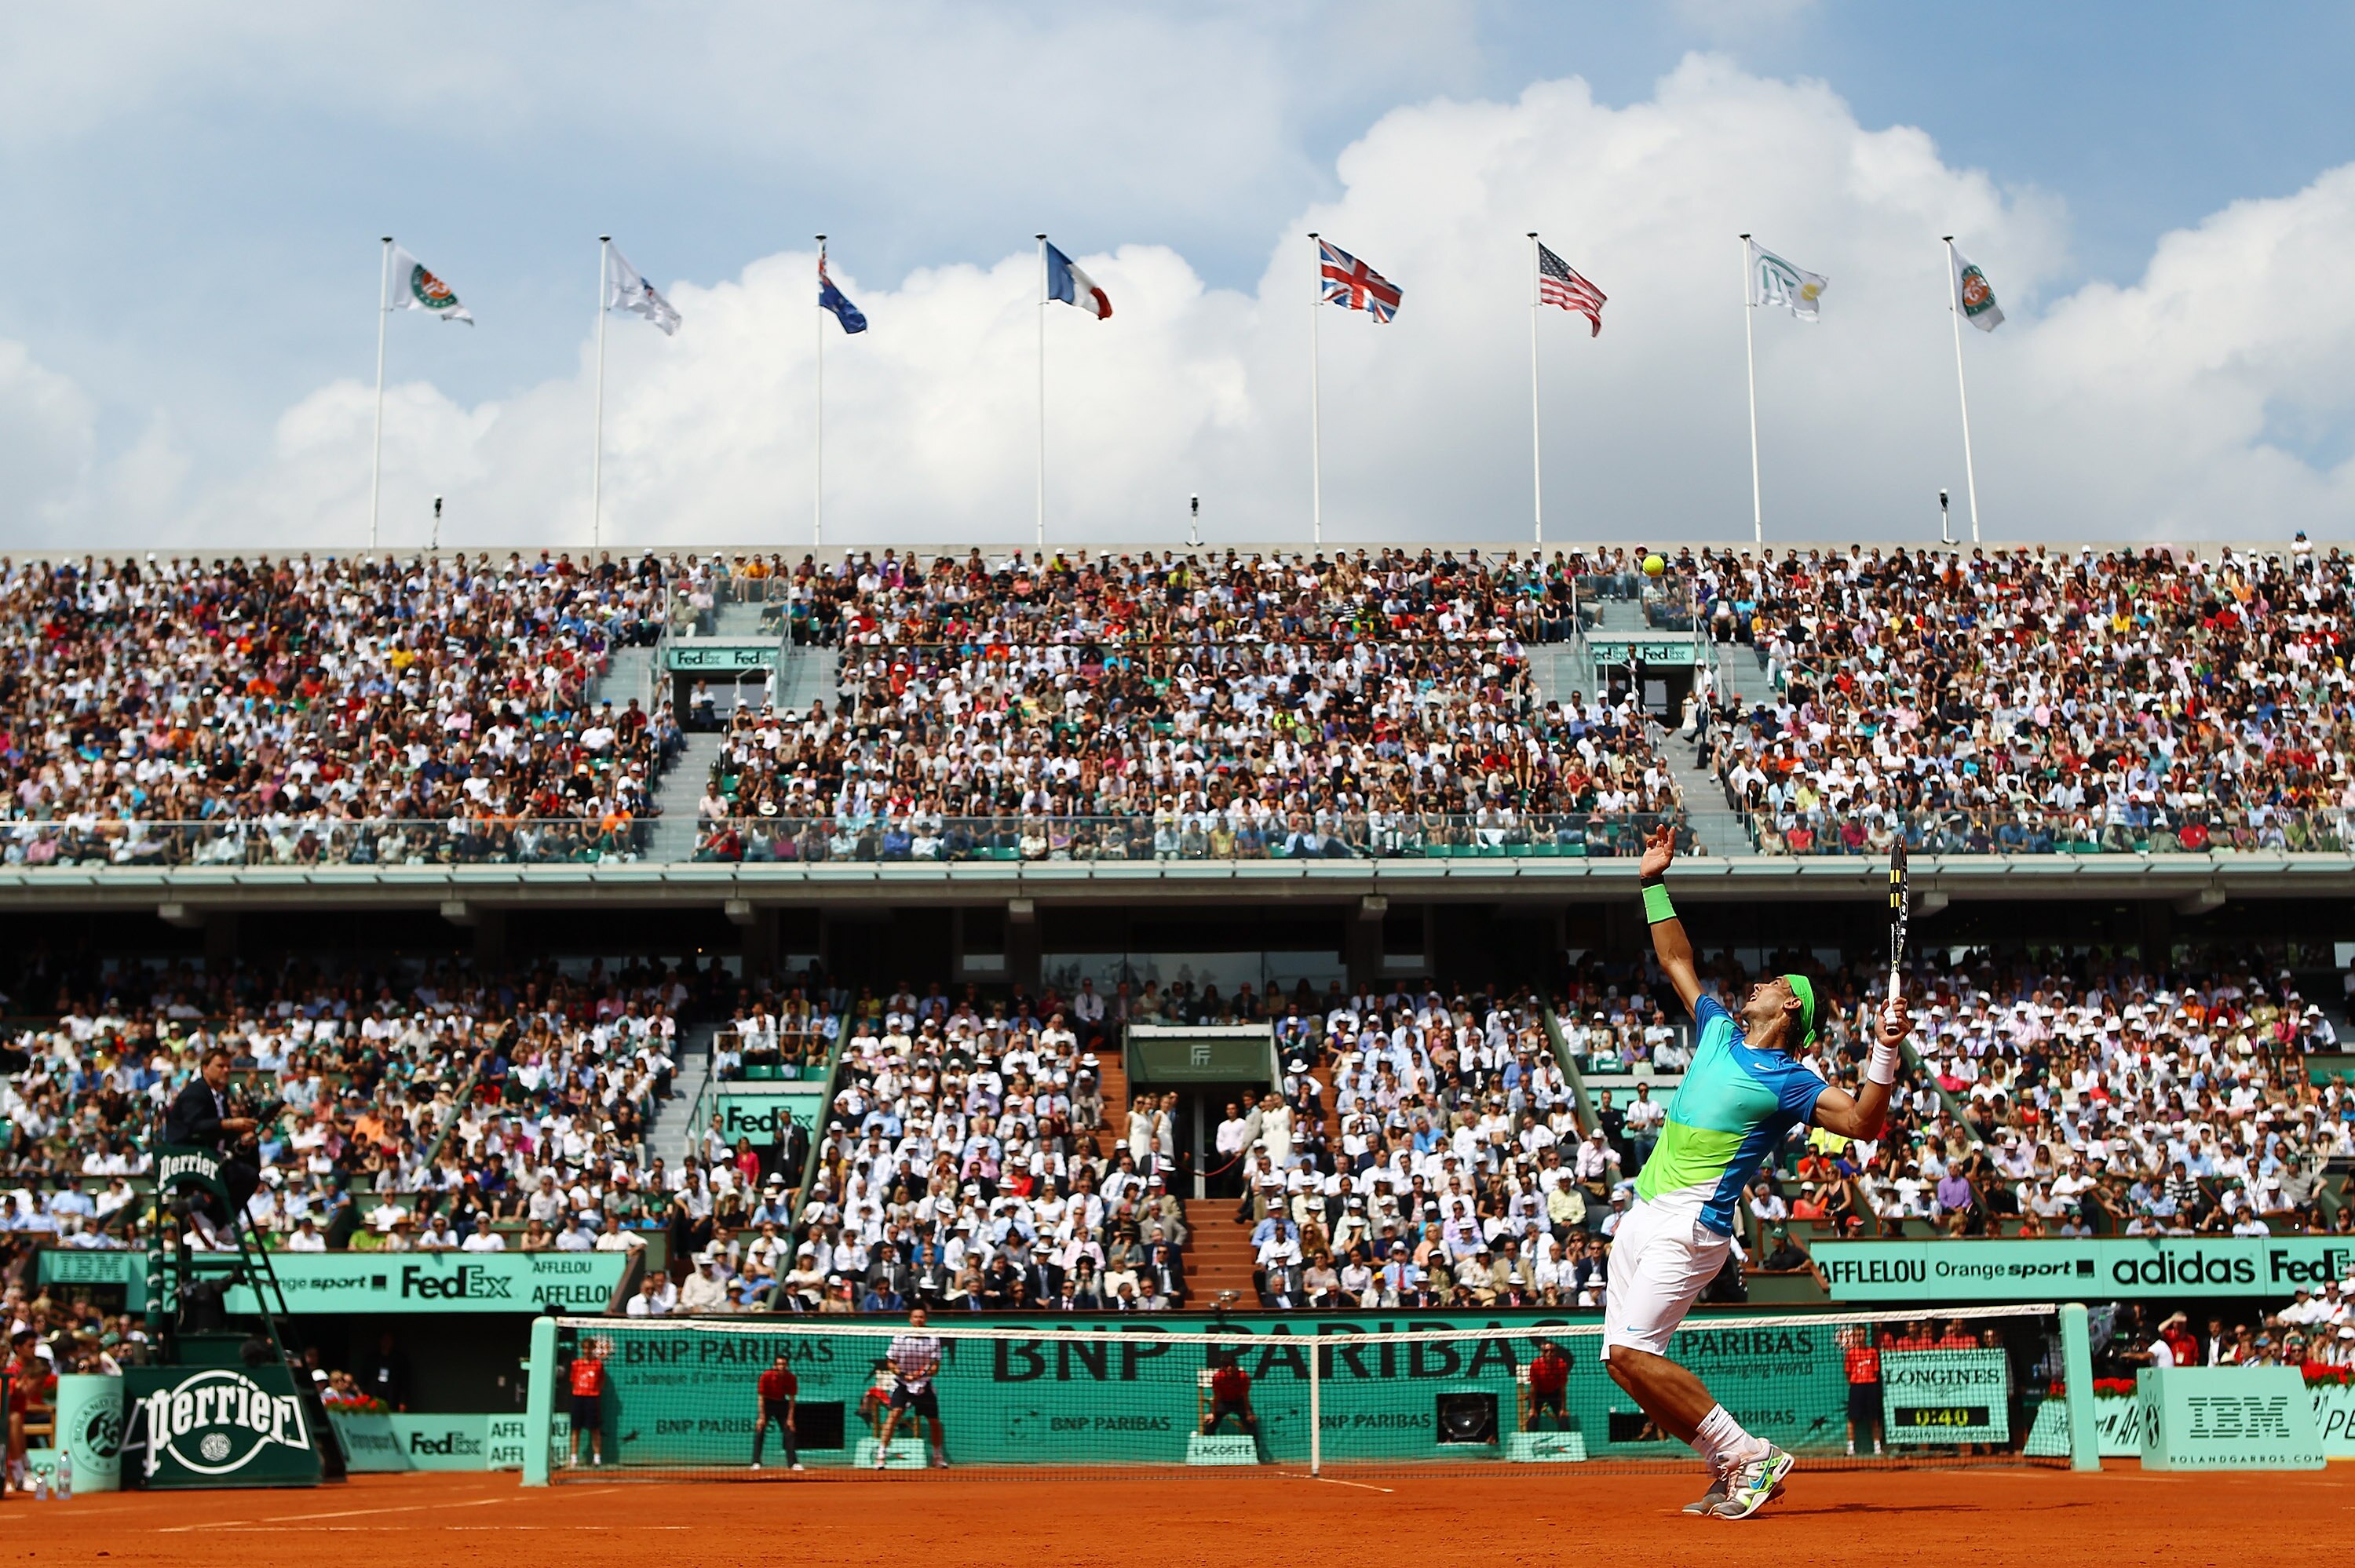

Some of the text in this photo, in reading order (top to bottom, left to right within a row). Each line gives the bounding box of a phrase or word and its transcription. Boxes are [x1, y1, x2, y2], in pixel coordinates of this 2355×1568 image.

[677, 651, 721, 665] FedEx
[1642, 646, 1685, 661] FedEx
[58, 1256, 123, 1278] IBM
[532, 1261, 592, 1274] AFFLELOU
[1818, 1259, 1926, 1283] AFFLELOU
[1935, 1260, 2072, 1280] Orange sport
[2112, 1250, 2255, 1285] adidas
[2270, 1249, 2355, 1282] FedE
[311, 1275, 366, 1291] sport
[401, 1265, 512, 1298] FedEx
[625, 1336, 834, 1364] BNP PARIBAS
[1681, 1330, 1813, 1356] PARIBAS
[993, 1325, 1171, 1382] BNP
[1886, 1369, 1999, 1384] LONGINES
[655, 1419, 693, 1435] BNP
[1050, 1416, 1171, 1431] BNP PARIBAS
[1354, 1413, 1432, 1428] PARIBAS
[1915, 1409, 1969, 1426] 0:40
[2188, 1396, 2290, 1439] IBM
[411, 1431, 483, 1455] FedEx
[1194, 1445, 1251, 1456] LACOSTE
